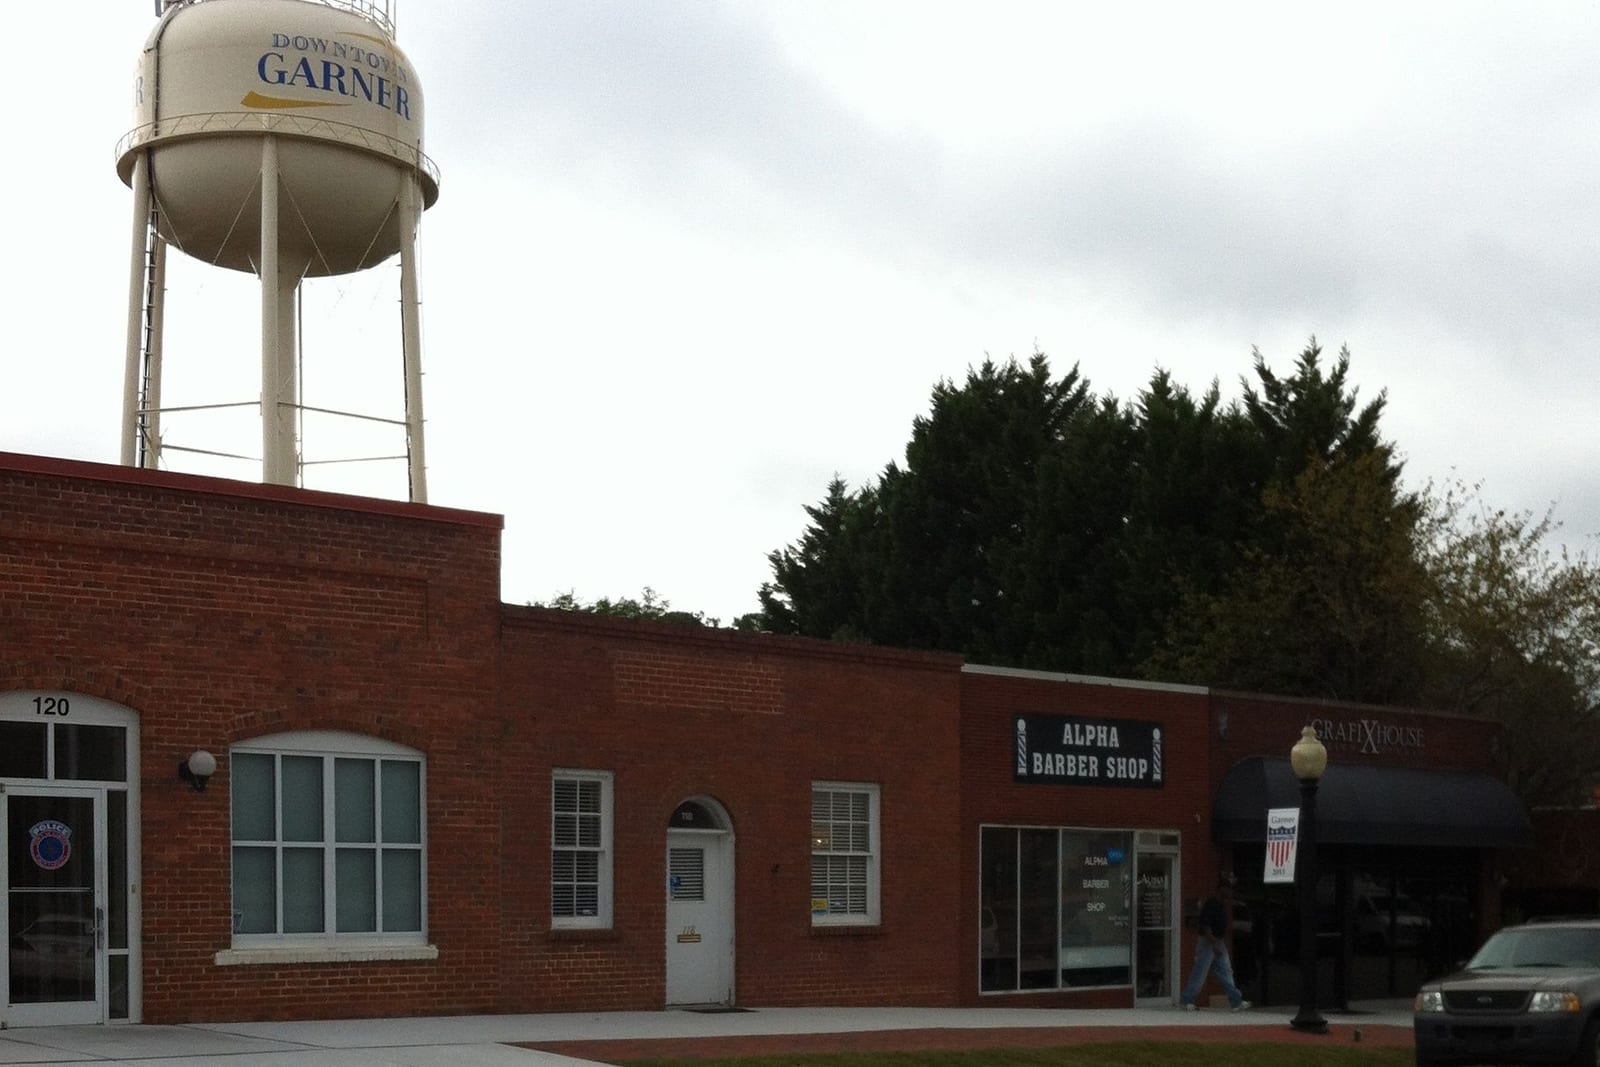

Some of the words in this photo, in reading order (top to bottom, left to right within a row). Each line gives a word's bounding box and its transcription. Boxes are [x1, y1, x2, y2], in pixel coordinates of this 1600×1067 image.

[257, 52, 411, 121] GARNER
[33, 696, 70, 716] 120
[1062, 723, 1120, 748] ALPHA
[1032, 752, 1099, 777] BARBER
[1106, 757, 1148, 780] SHOP
[32, 823, 69, 836] POLICE
[1084, 856, 1109, 866] ALPHA
[1082, 879, 1110, 889] BARBER
[1086, 902, 1106, 912] SHOP
